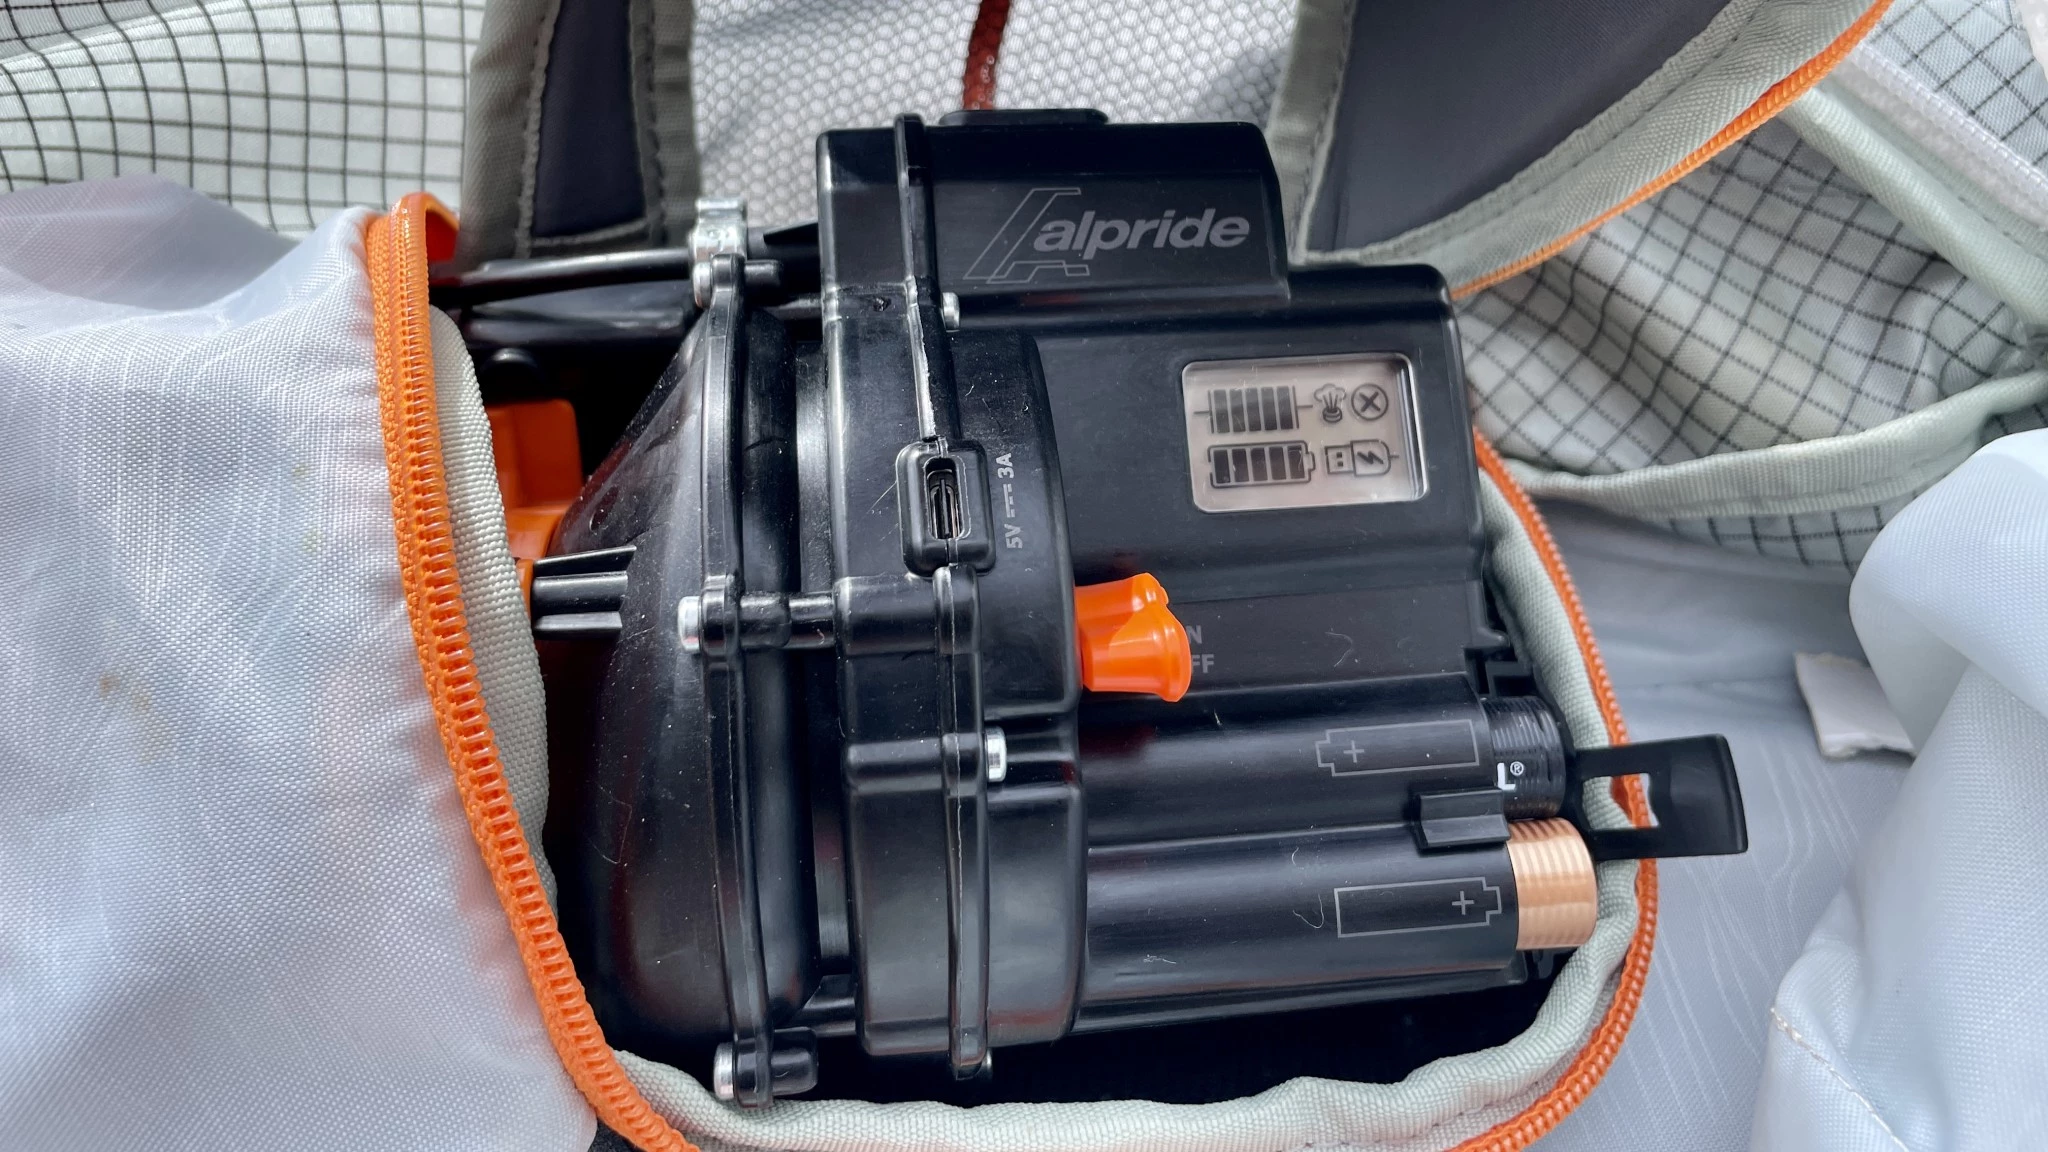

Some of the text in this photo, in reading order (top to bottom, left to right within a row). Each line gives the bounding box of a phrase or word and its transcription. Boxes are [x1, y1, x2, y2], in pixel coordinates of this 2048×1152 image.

[1033, 208, 1250, 260] alpride
[996, 452, 1023, 549] 5V 3A
[1185, 624, 1203, 645] N
[1191, 653, 1215, 674] FF
